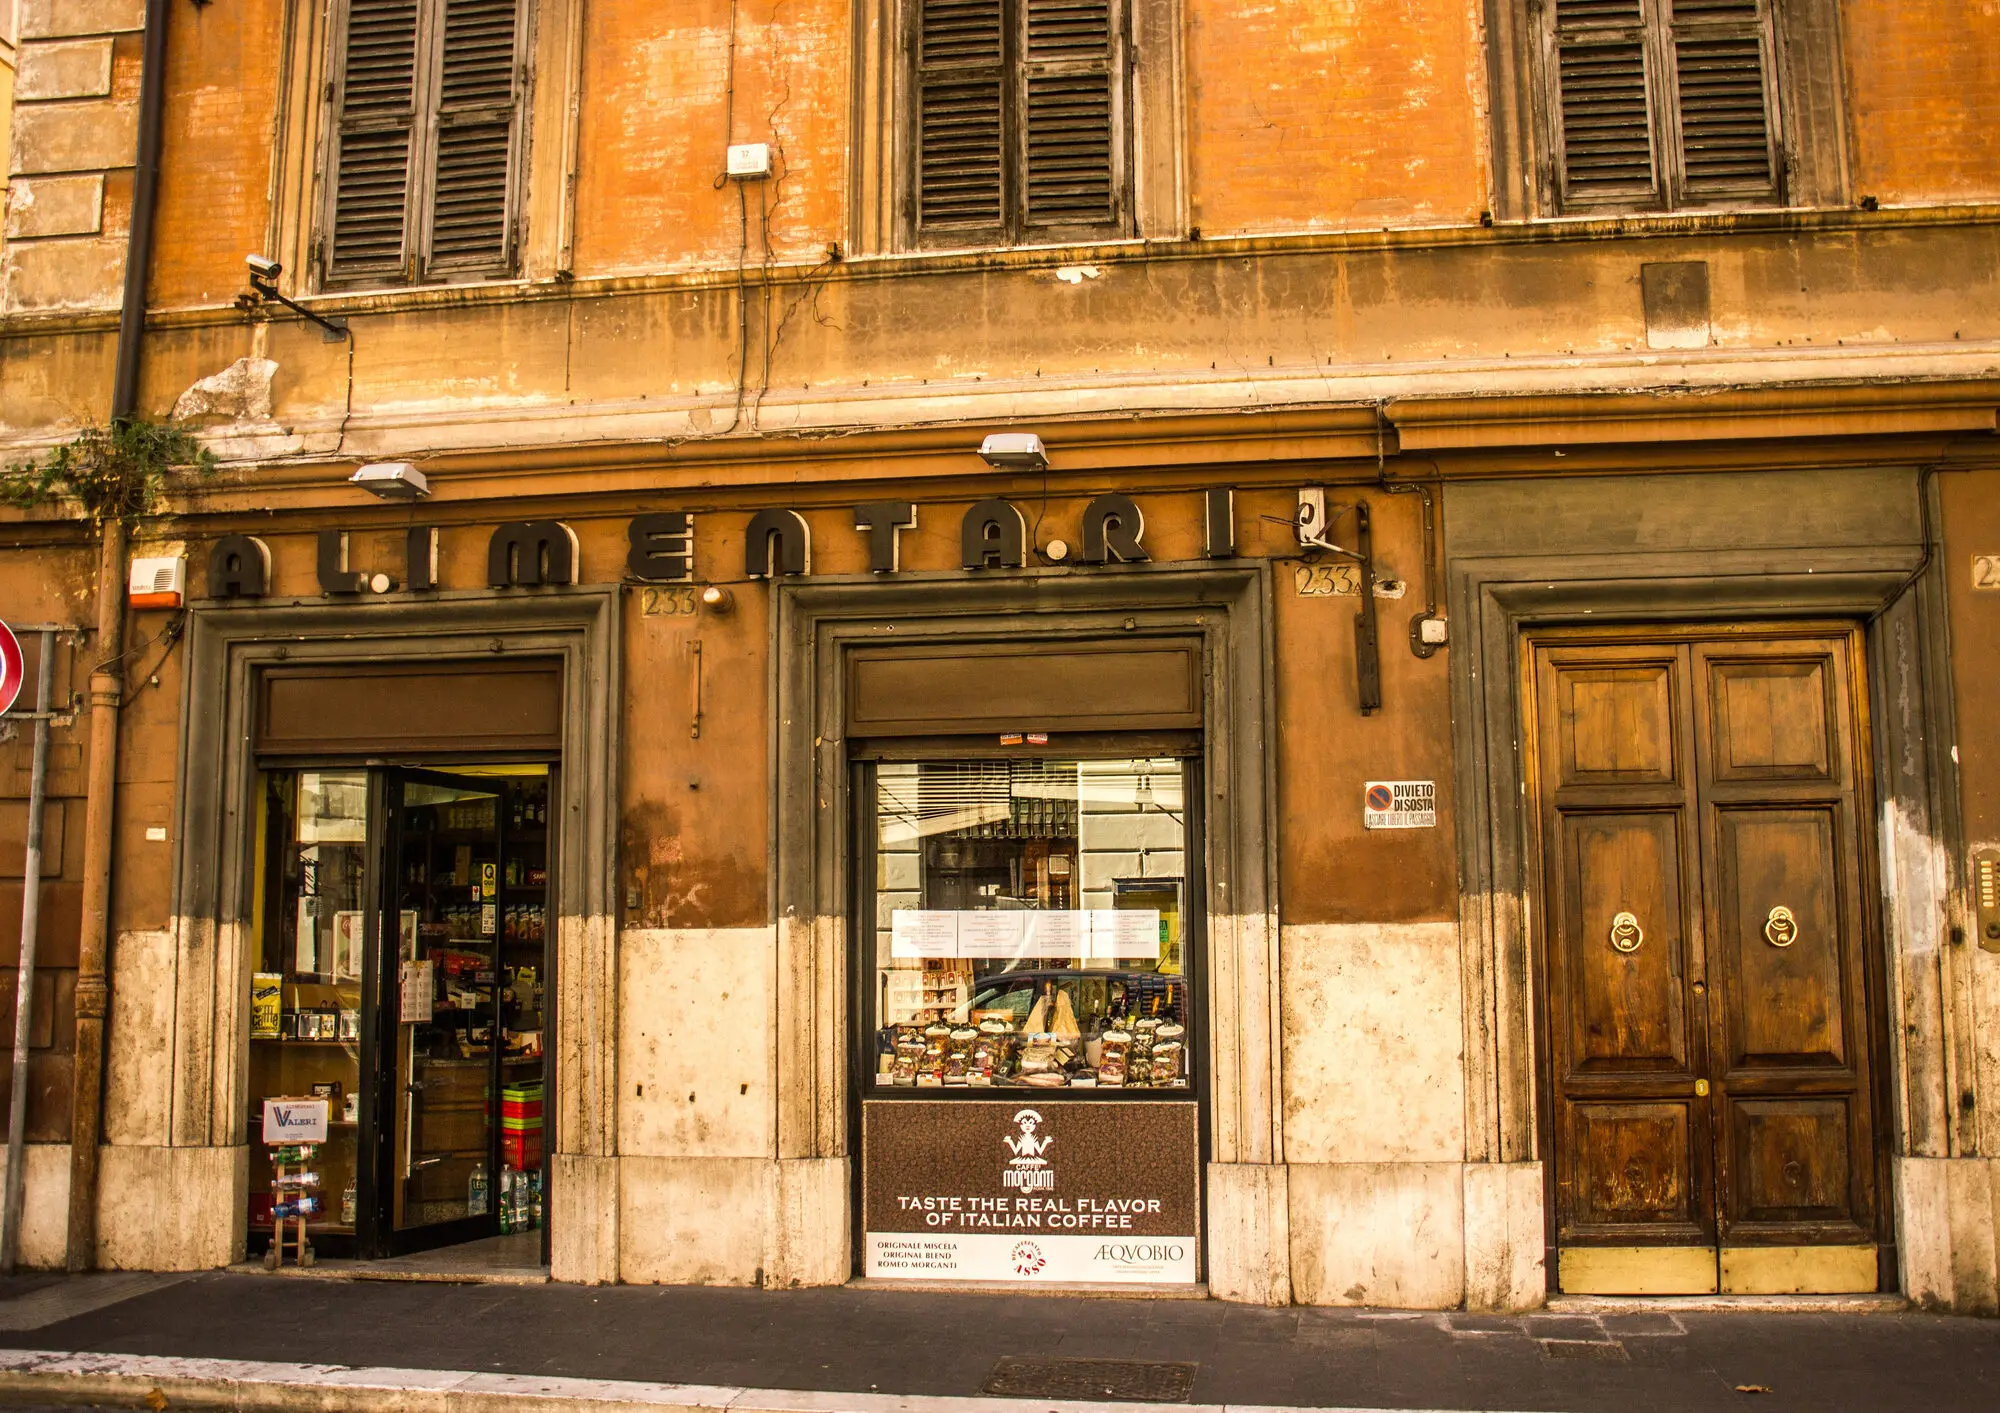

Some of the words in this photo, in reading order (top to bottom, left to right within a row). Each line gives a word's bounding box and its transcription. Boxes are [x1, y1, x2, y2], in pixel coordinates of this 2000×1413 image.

[208, 487, 1235, 598] ALIMENTARI
[1975, 556, 2000, 587] 2
[644, 588, 697, 615] 233
[1394, 784, 1434, 797] DIVIETO
[1394, 799, 1403, 812] DI
[1404, 799, 1434, 812] SOSTA
[273, 1106, 317, 1127] VALERI
[897, 1196, 961, 1211] TASTE
[967, 1197, 1009, 1212] THE
[1016, 1198, 1071, 1212] REAL
[1078, 1199, 1161, 1213] FLAVOR
[926, 1212, 951, 1227] OF
[960, 1213, 1041, 1227] ITALIAN
[1048, 1214, 1132, 1229] COFFEE
[877, 1242, 921, 1250] ORIGINALE
[924, 1242, 958, 1250] MISCELA
[883, 1251, 922, 1259] ORIGINAL
[925, 1252, 952, 1260] BLEND
[877, 1260, 909, 1268] ROMEO
[911, 1261, 957, 1269] MORGANTI
